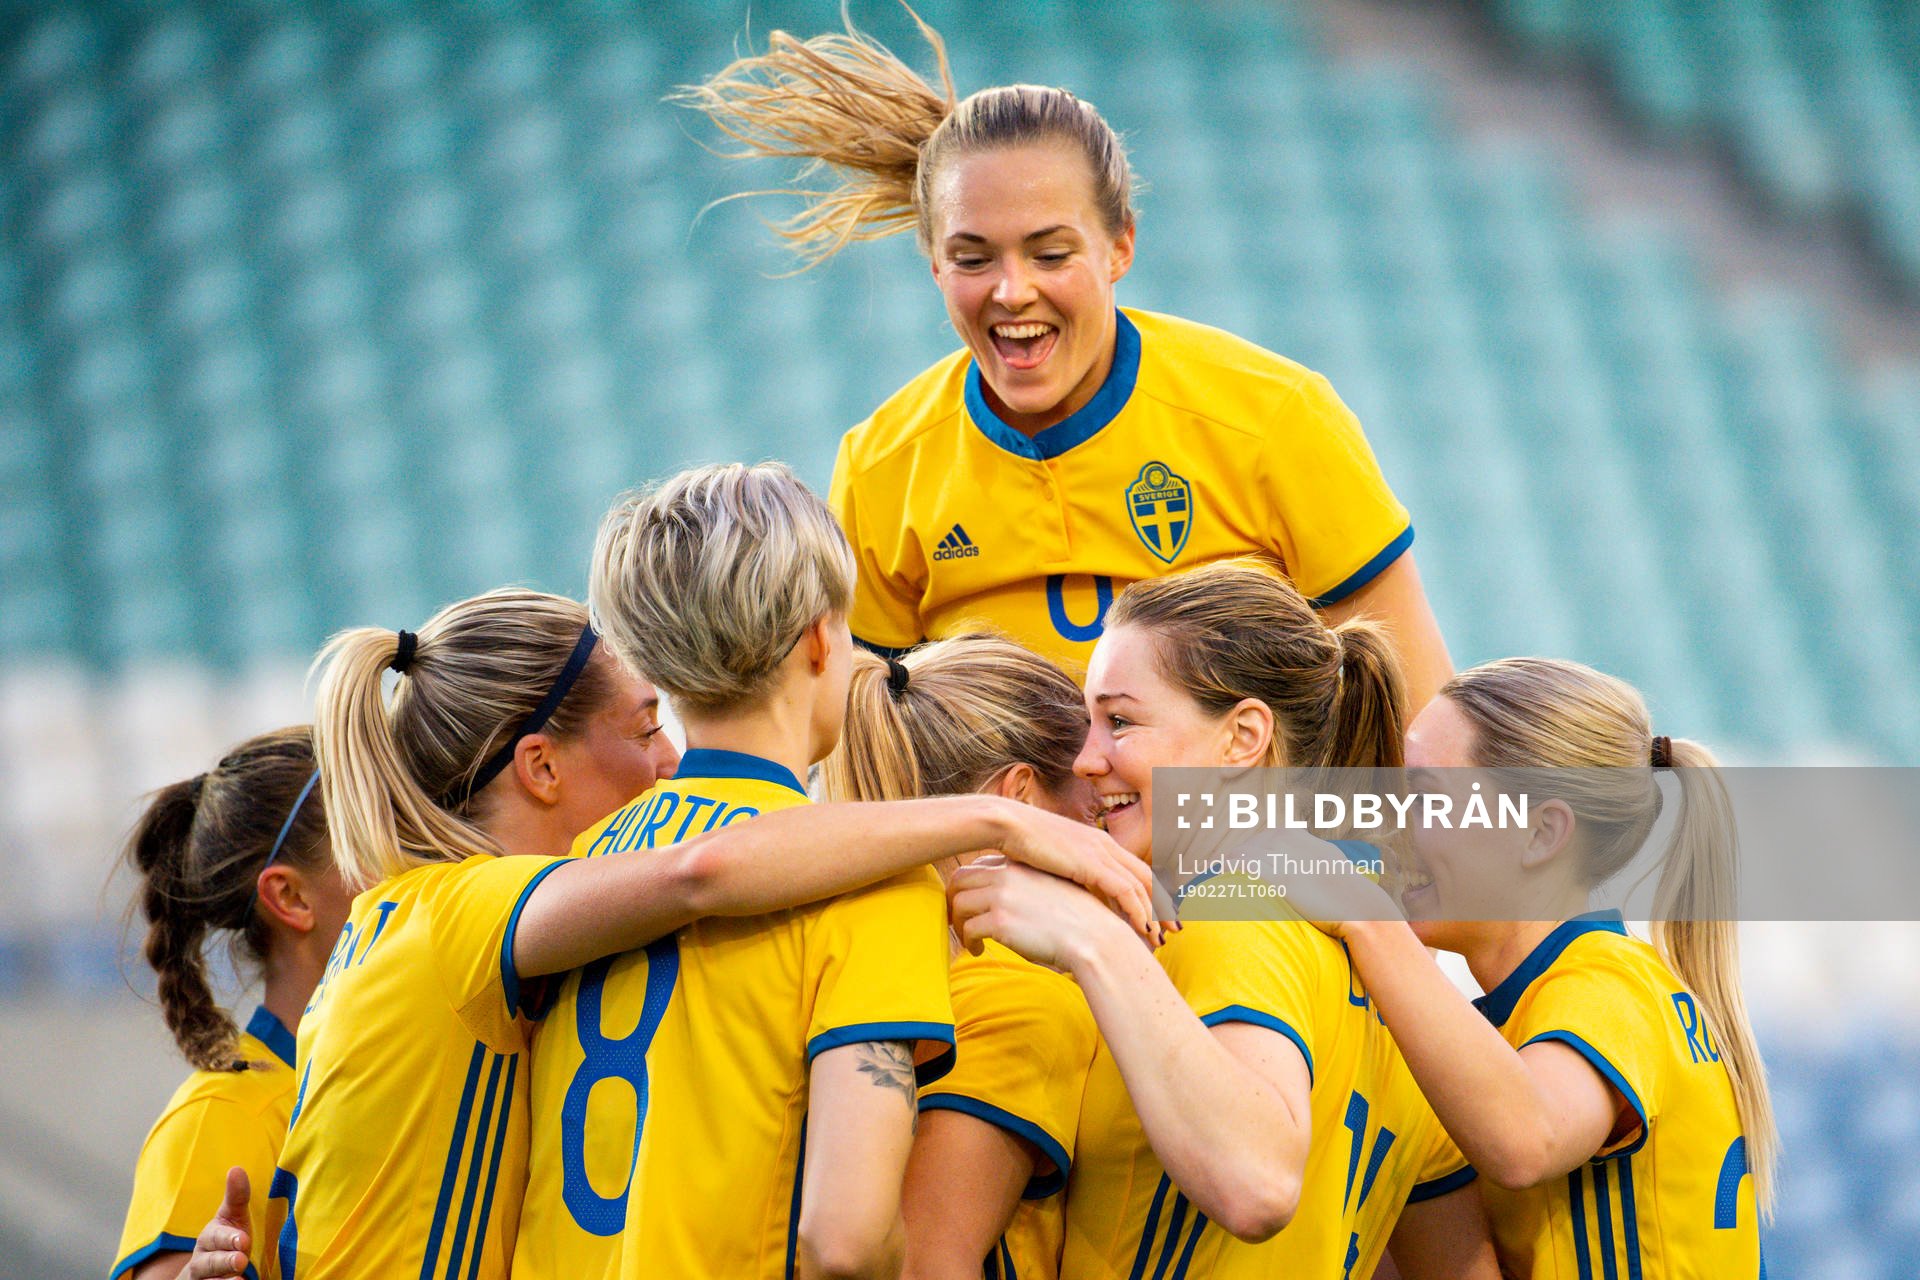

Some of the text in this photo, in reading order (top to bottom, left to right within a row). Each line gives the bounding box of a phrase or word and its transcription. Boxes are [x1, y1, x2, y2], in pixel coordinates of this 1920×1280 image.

[1138, 488, 1179, 501] SVERIGE
[932, 544, 980, 561] adidas
[586, 791, 761, 858] HURTI
[560, 932, 680, 1237] 8
